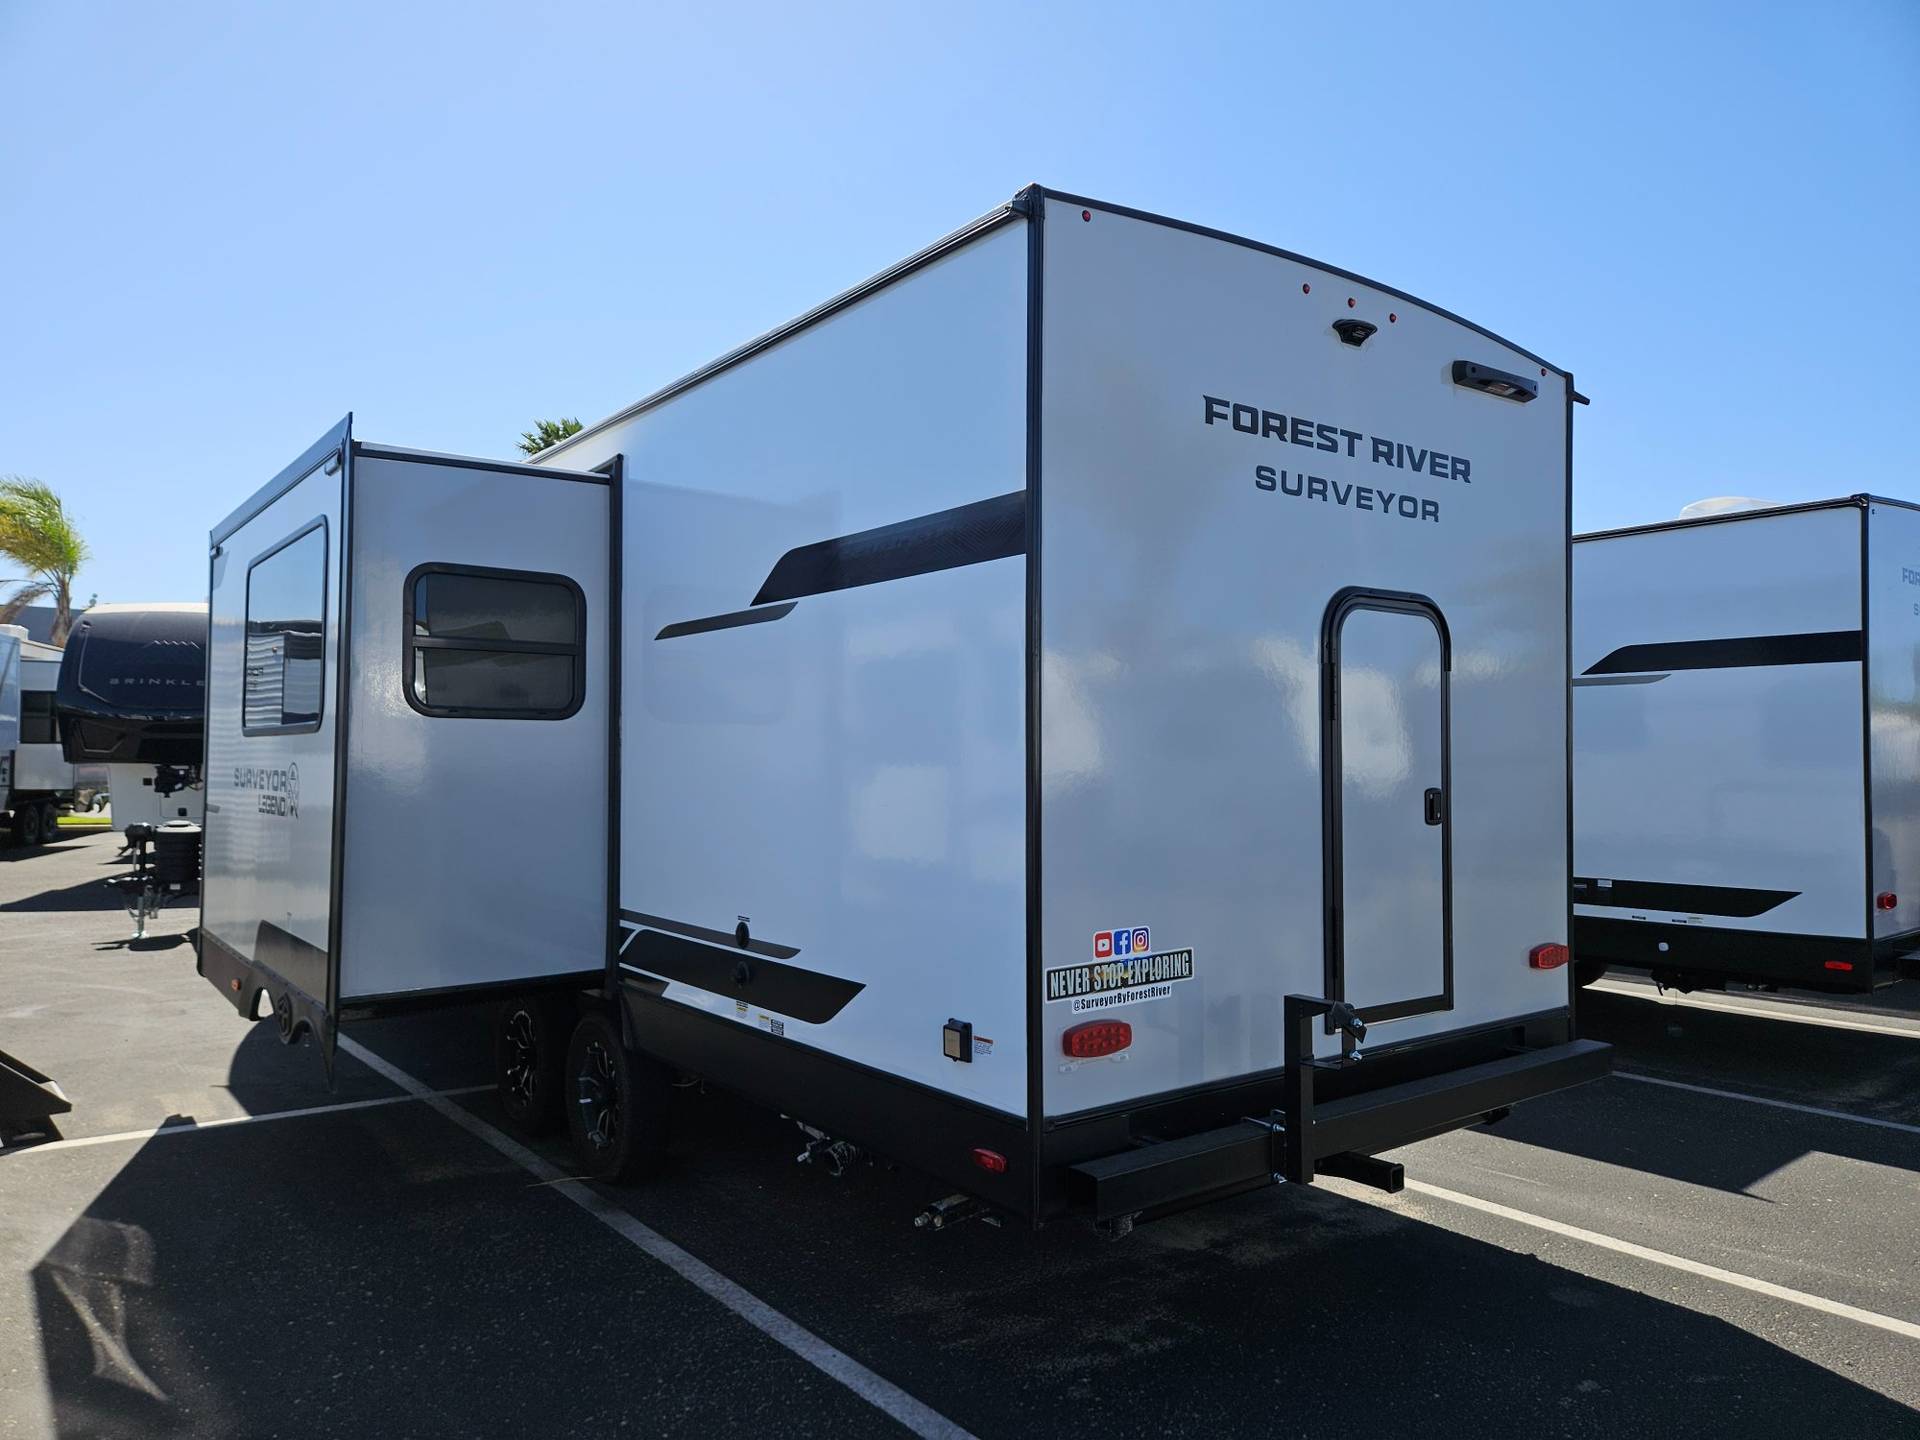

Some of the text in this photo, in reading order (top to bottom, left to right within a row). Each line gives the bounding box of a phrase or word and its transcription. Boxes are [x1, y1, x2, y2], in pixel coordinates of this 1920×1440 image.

[1203, 394, 1471, 484] FOREST RIVER
[1255, 464, 1440, 523] SURVEYOR
[234, 767, 287, 792] SURVEYOR
[258, 794, 286, 817] LEGEND
[1050, 952, 1190, 998] NEVER STOP EXPLORING
[1073, 984, 1171, 1012] @SurveyorByForestRiver
